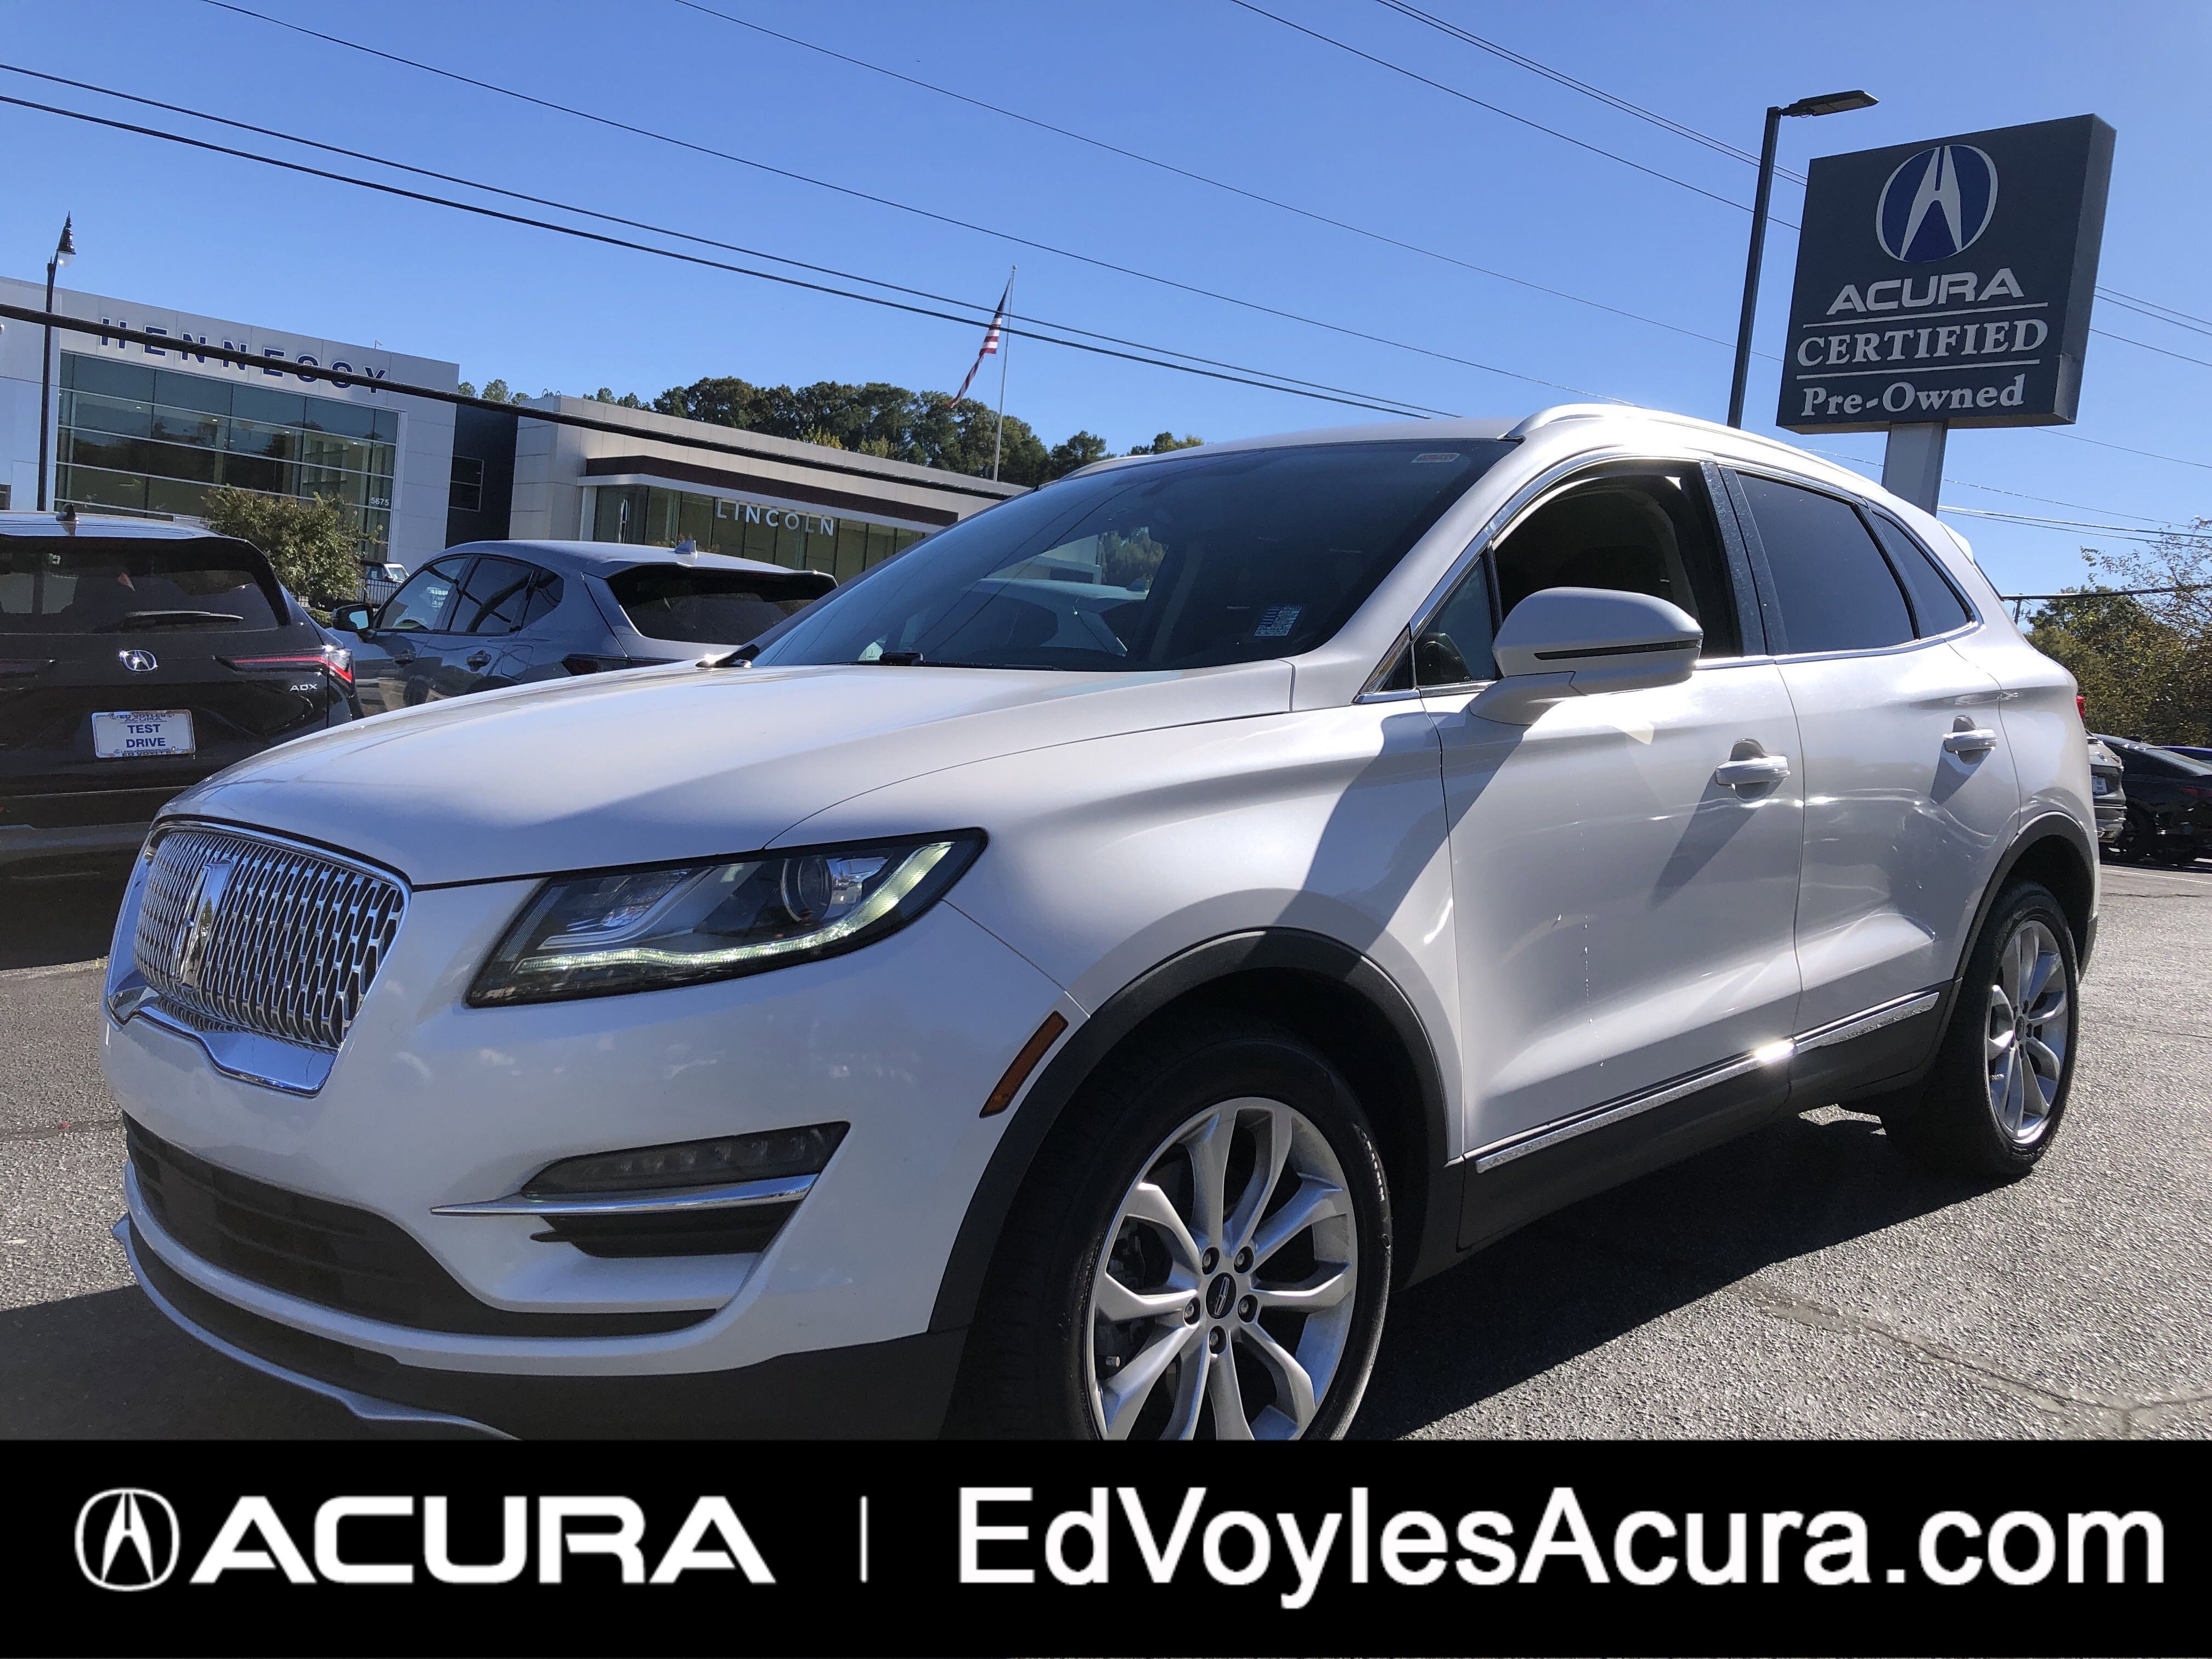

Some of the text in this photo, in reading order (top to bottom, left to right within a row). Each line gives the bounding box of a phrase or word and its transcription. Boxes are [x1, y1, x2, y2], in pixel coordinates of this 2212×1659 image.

[1826, 267, 2025, 315] ACURA
[100, 317, 387, 394] HENNESSY
[1797, 318, 2049, 367] CERTIFIED
[1801, 373, 2026, 416] Pre-Owned
[370, 496, 390, 506] 5675
[716, 497, 834, 536] LINCOLN
[126, 737, 166, 748] DRIVE
[127, 724, 161, 733] TEST
